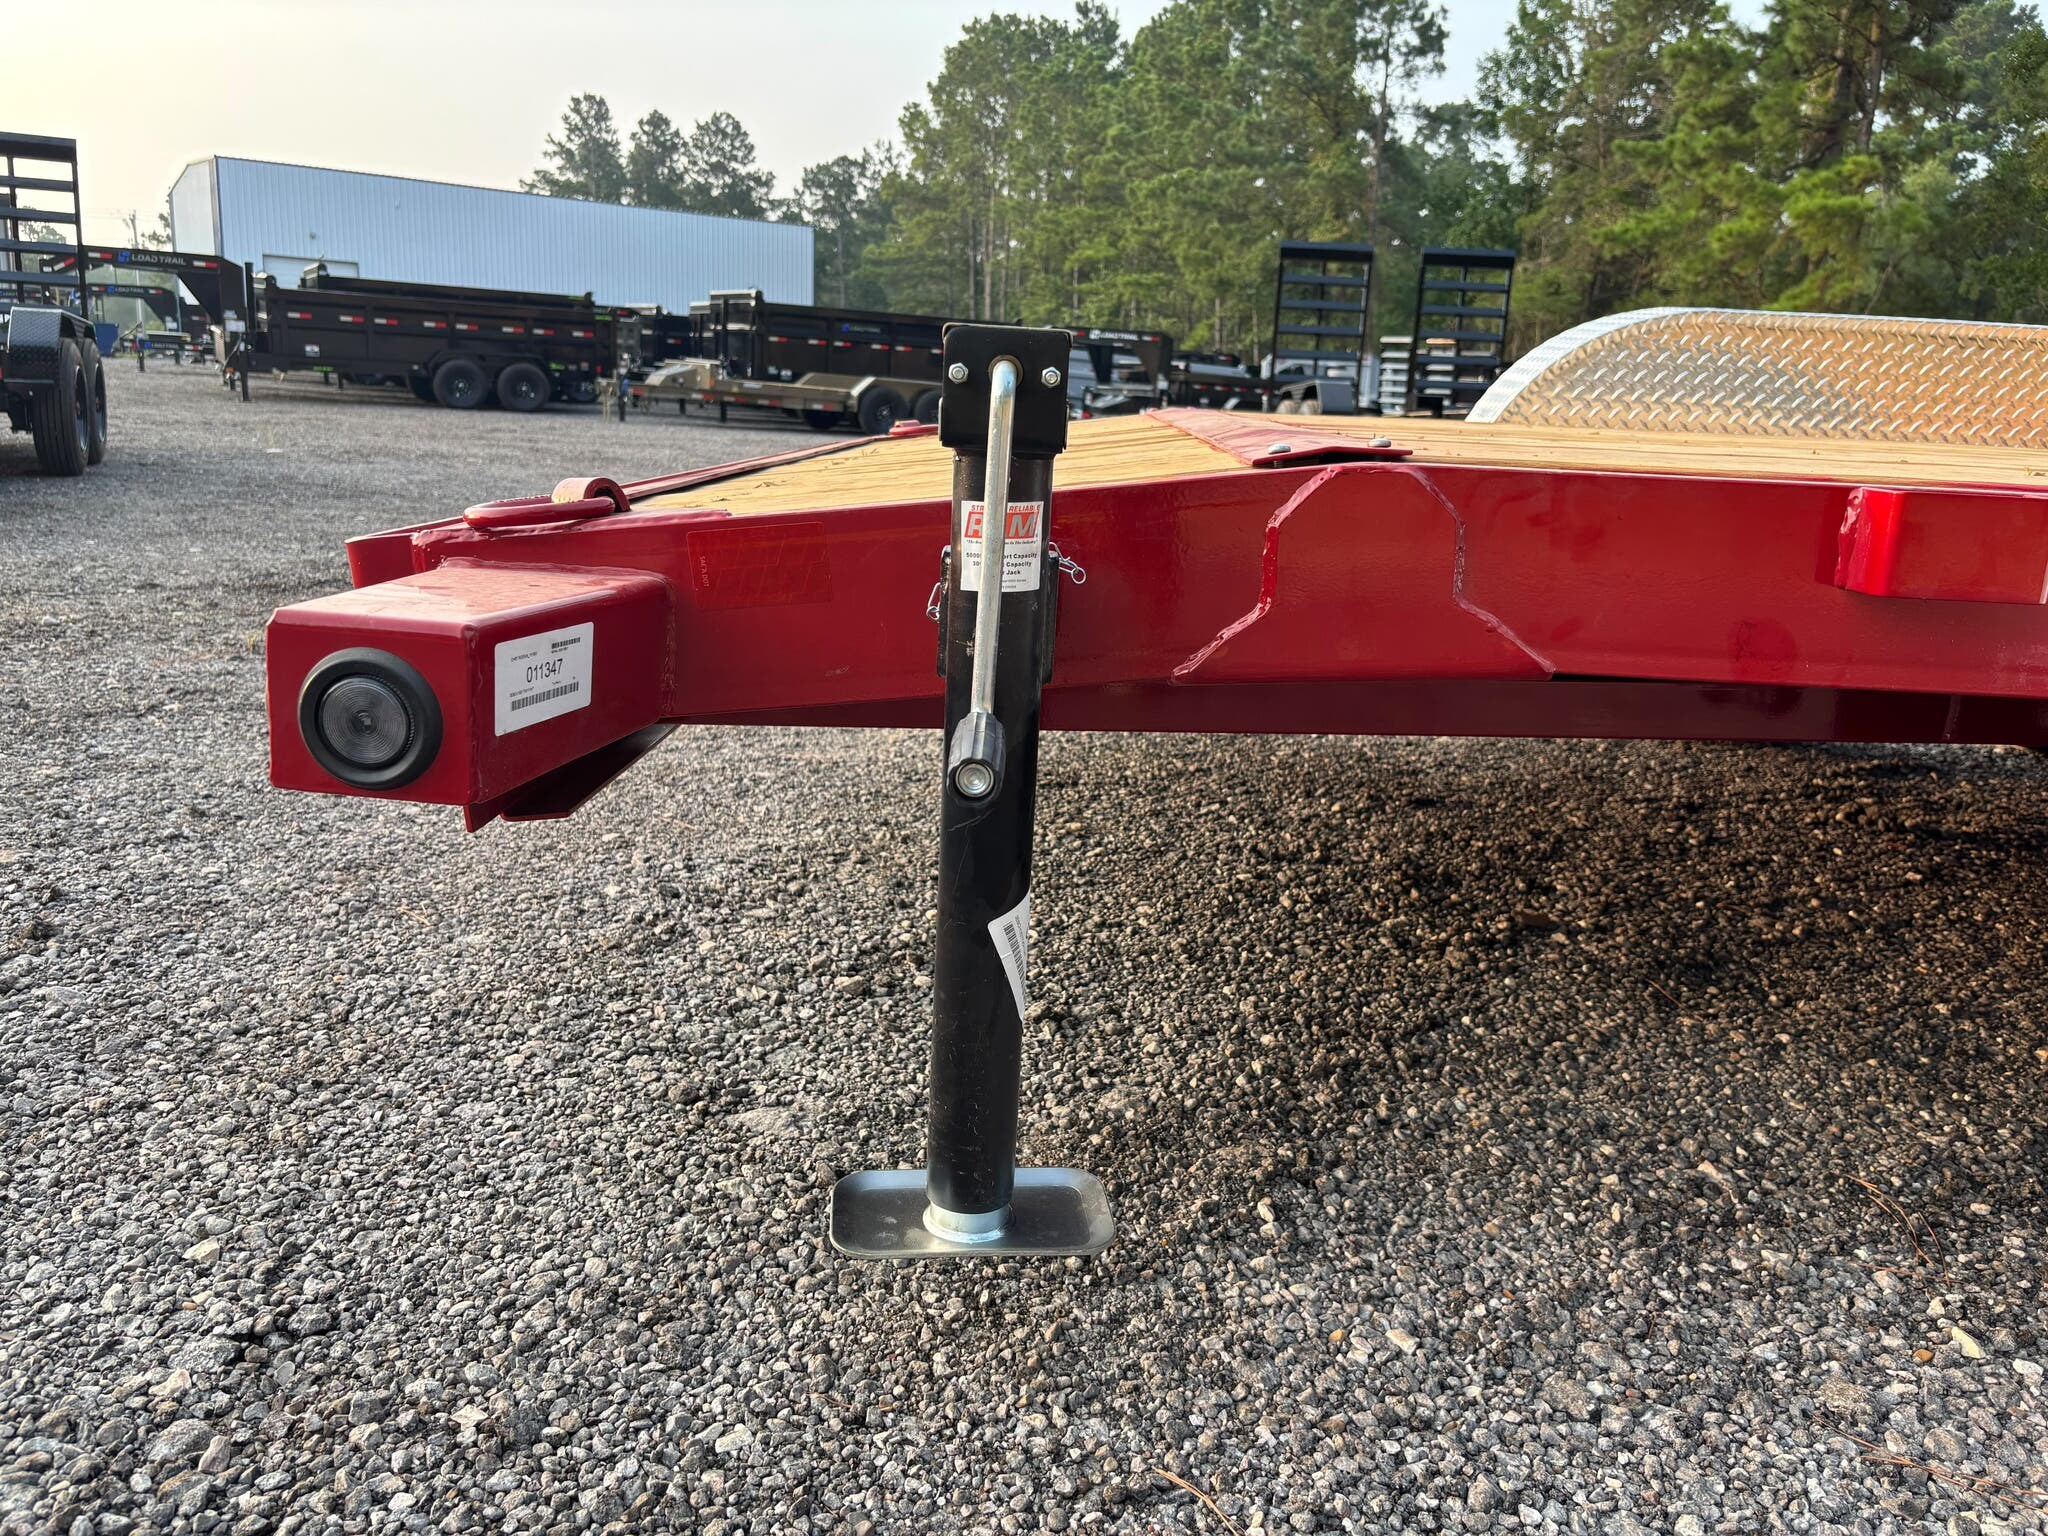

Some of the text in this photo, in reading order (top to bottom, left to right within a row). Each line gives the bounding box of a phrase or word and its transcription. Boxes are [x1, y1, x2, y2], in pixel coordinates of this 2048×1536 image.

[132, 254, 187, 266] LOAD TRAIL
[968, 513, 1036, 537] RM
[526, 658, 563, 683] 011347
